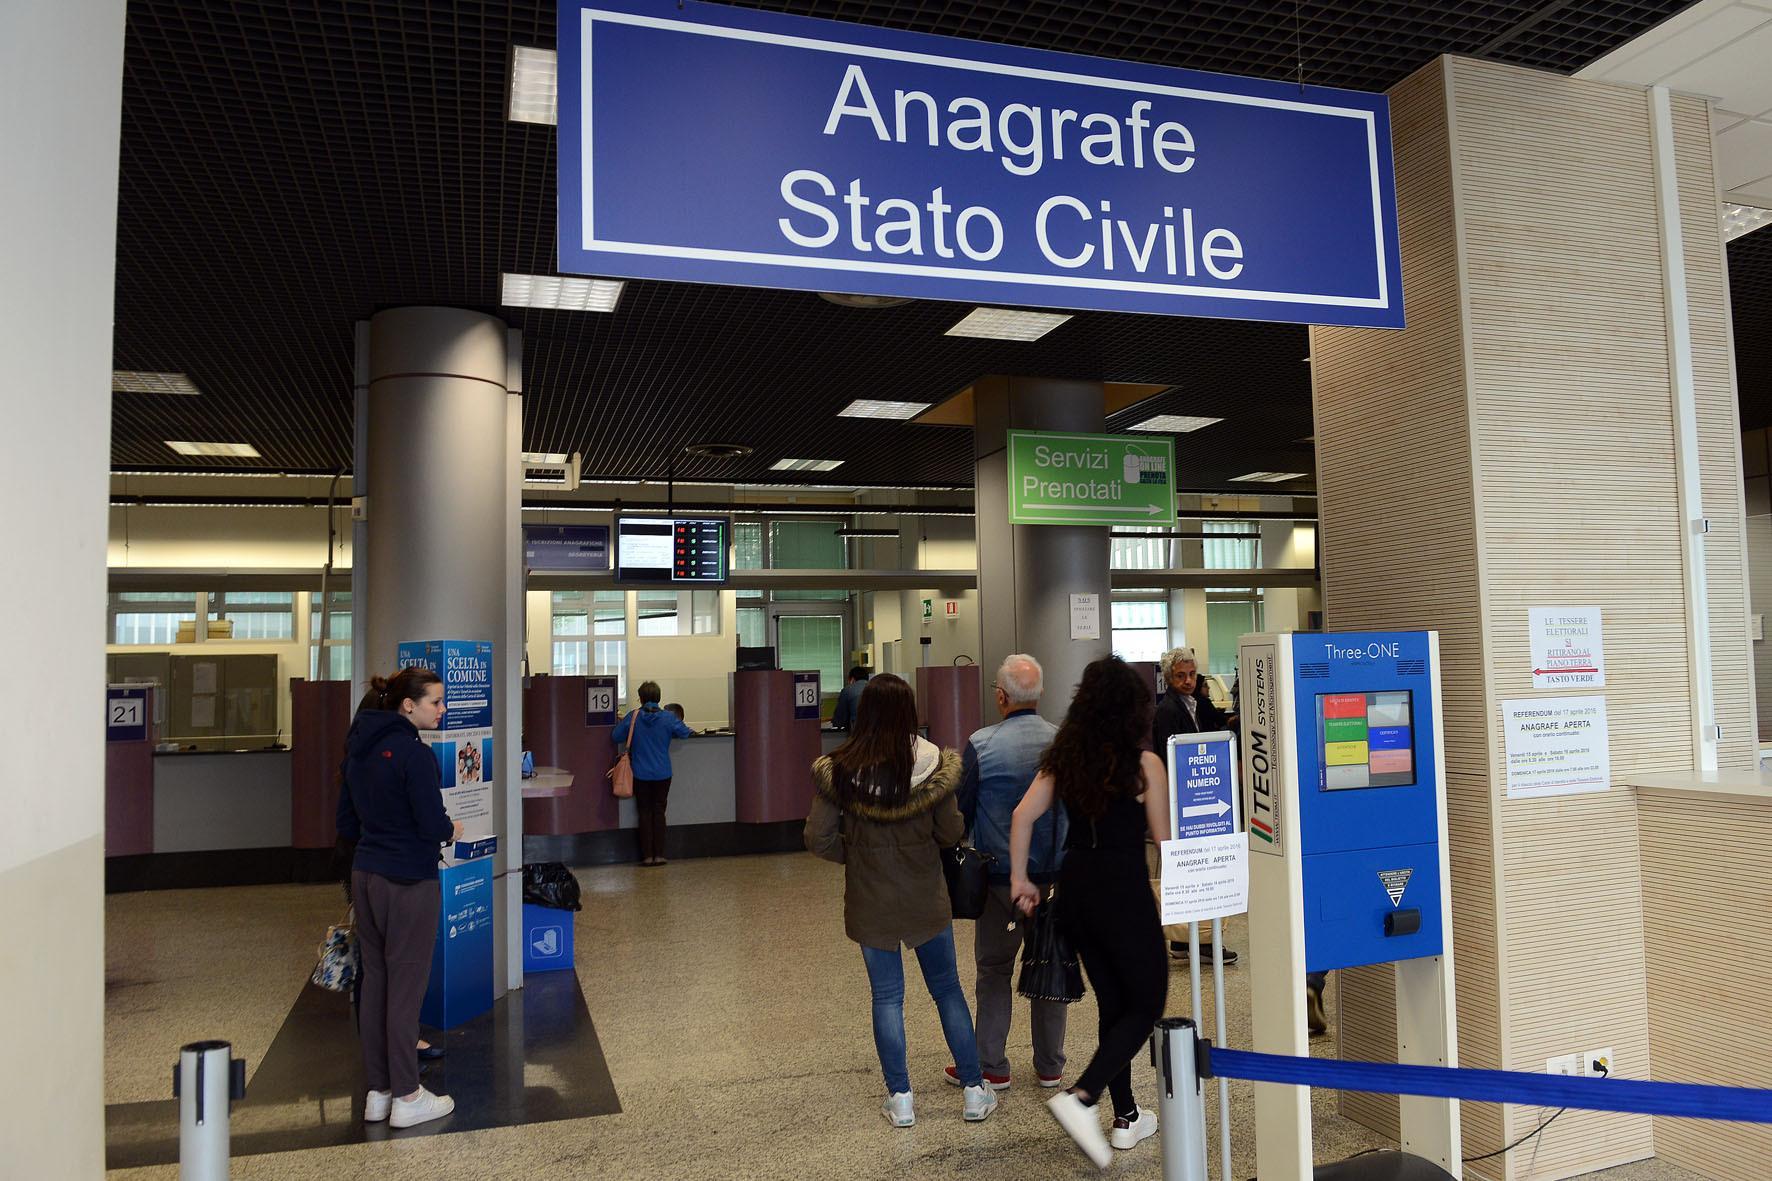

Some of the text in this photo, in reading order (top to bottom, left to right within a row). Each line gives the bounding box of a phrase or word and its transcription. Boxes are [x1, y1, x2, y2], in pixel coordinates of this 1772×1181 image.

[823, 64, 1196, 176] Anagrafe
[778, 169, 1244, 280] Stato Civile
[1035, 445, 1108, 469] Servizi
[1023, 475, 1121, 500] Prenotati
[1558, 617, 1588, 625] TESSERE
[1546, 628, 1588, 636] ELETTORALI
[448, 648, 460, 656] UNA
[1324, 642, 1399, 659] Three-ONE
[447, 657, 479, 669] SCELTA
[447, 670, 487, 682] COMUNE
[799, 689, 814, 703] 18
[1256, 658, 1265, 726] SYSTEMS
[592, 694, 610, 709] 19
[114, 706, 136, 722] 21
[1513, 710, 1552, 718] REFERENDUM
[1520, 722, 1558, 731] ANAGRAFE
[1188, 755, 1216, 765] PRENDI
[1192, 766, 1216, 776] IL TUO
[1251, 731, 1270, 814] TEOM
[1187, 777, 1220, 788] NUMERO
[1171, 848, 1202, 856] REFERENDUM
[1177, 855, 1236, 868] ANAGRAFE APERTA
